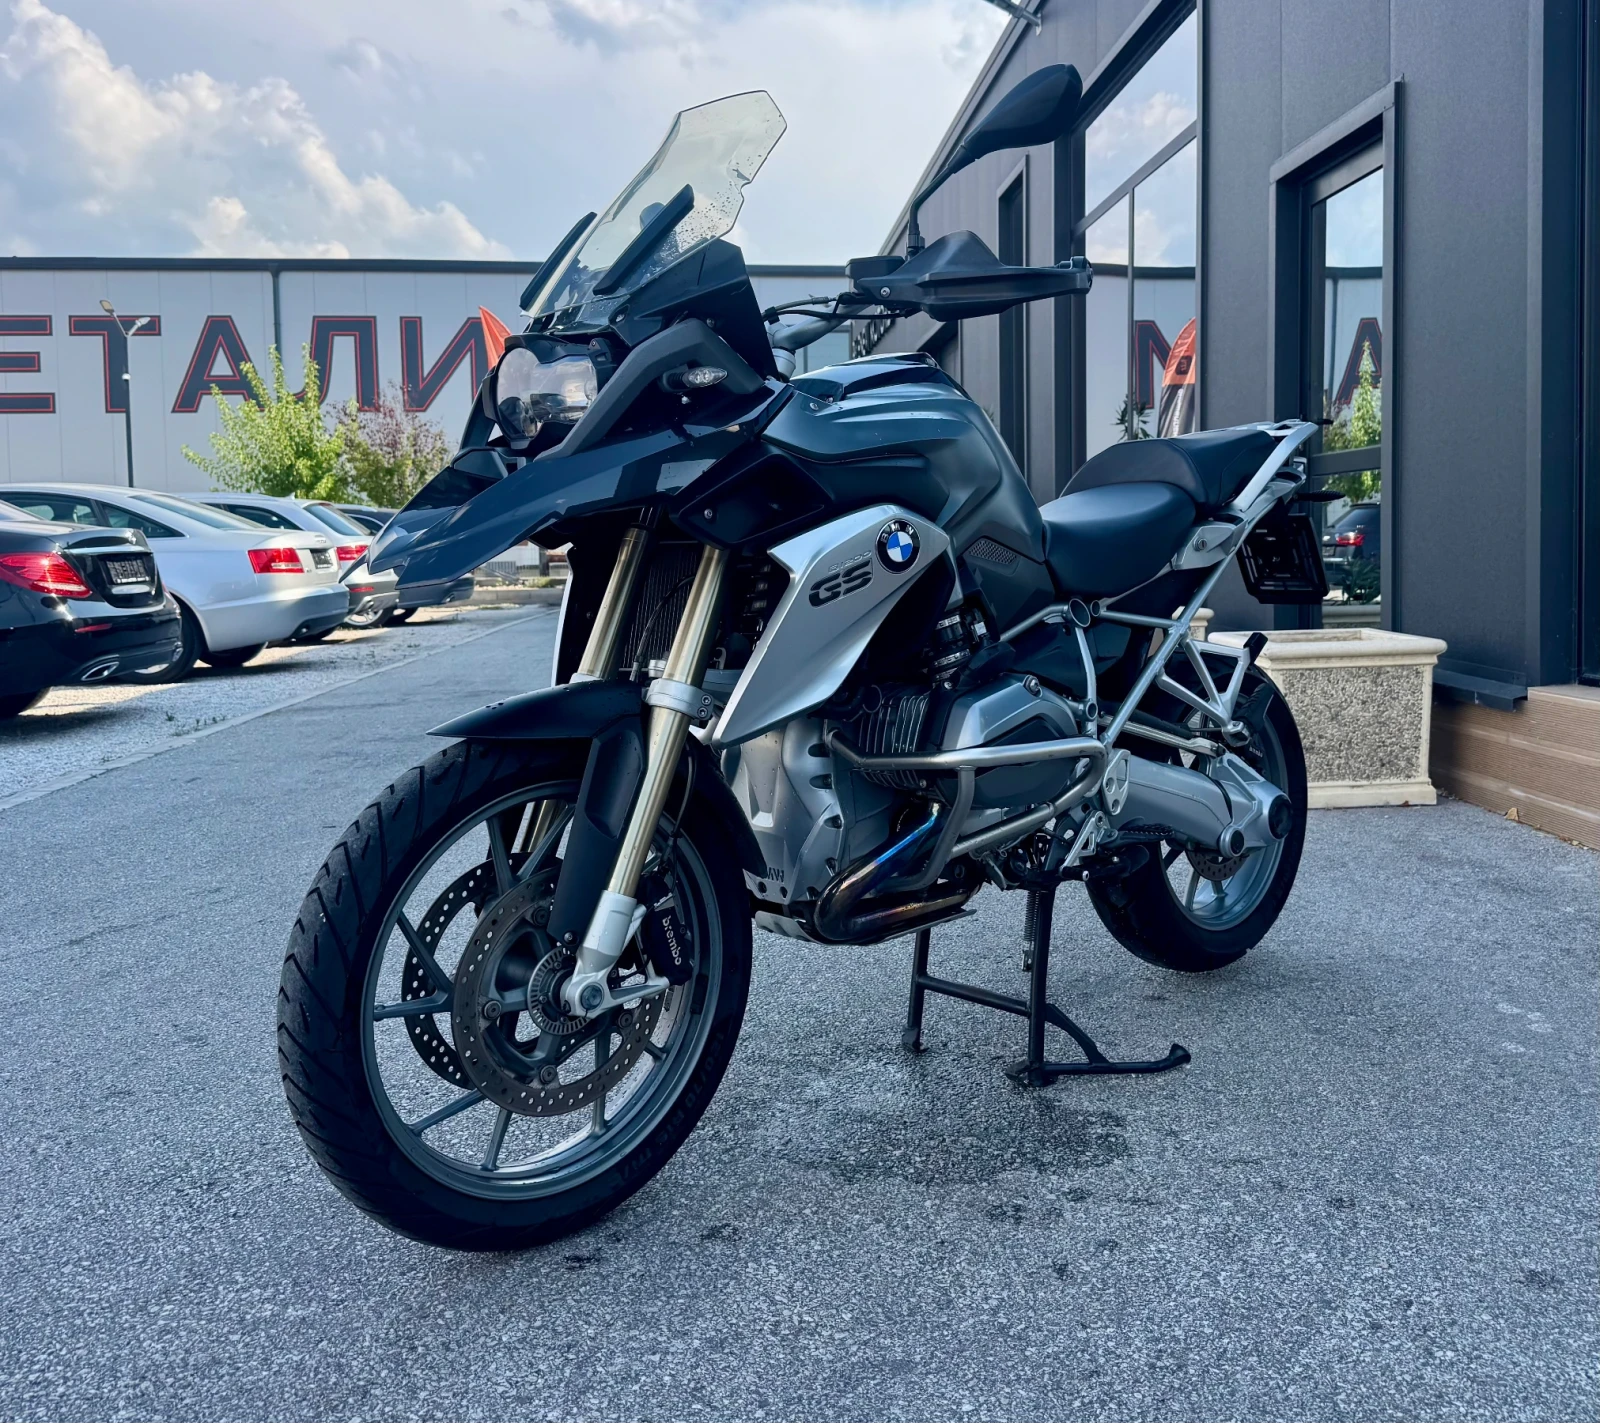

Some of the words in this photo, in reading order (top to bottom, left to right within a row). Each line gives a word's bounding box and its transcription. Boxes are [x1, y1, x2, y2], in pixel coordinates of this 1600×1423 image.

[879, 521, 914, 544] BMW
[808, 560, 873, 608] GS
[661, 914, 682, 966] brembo
